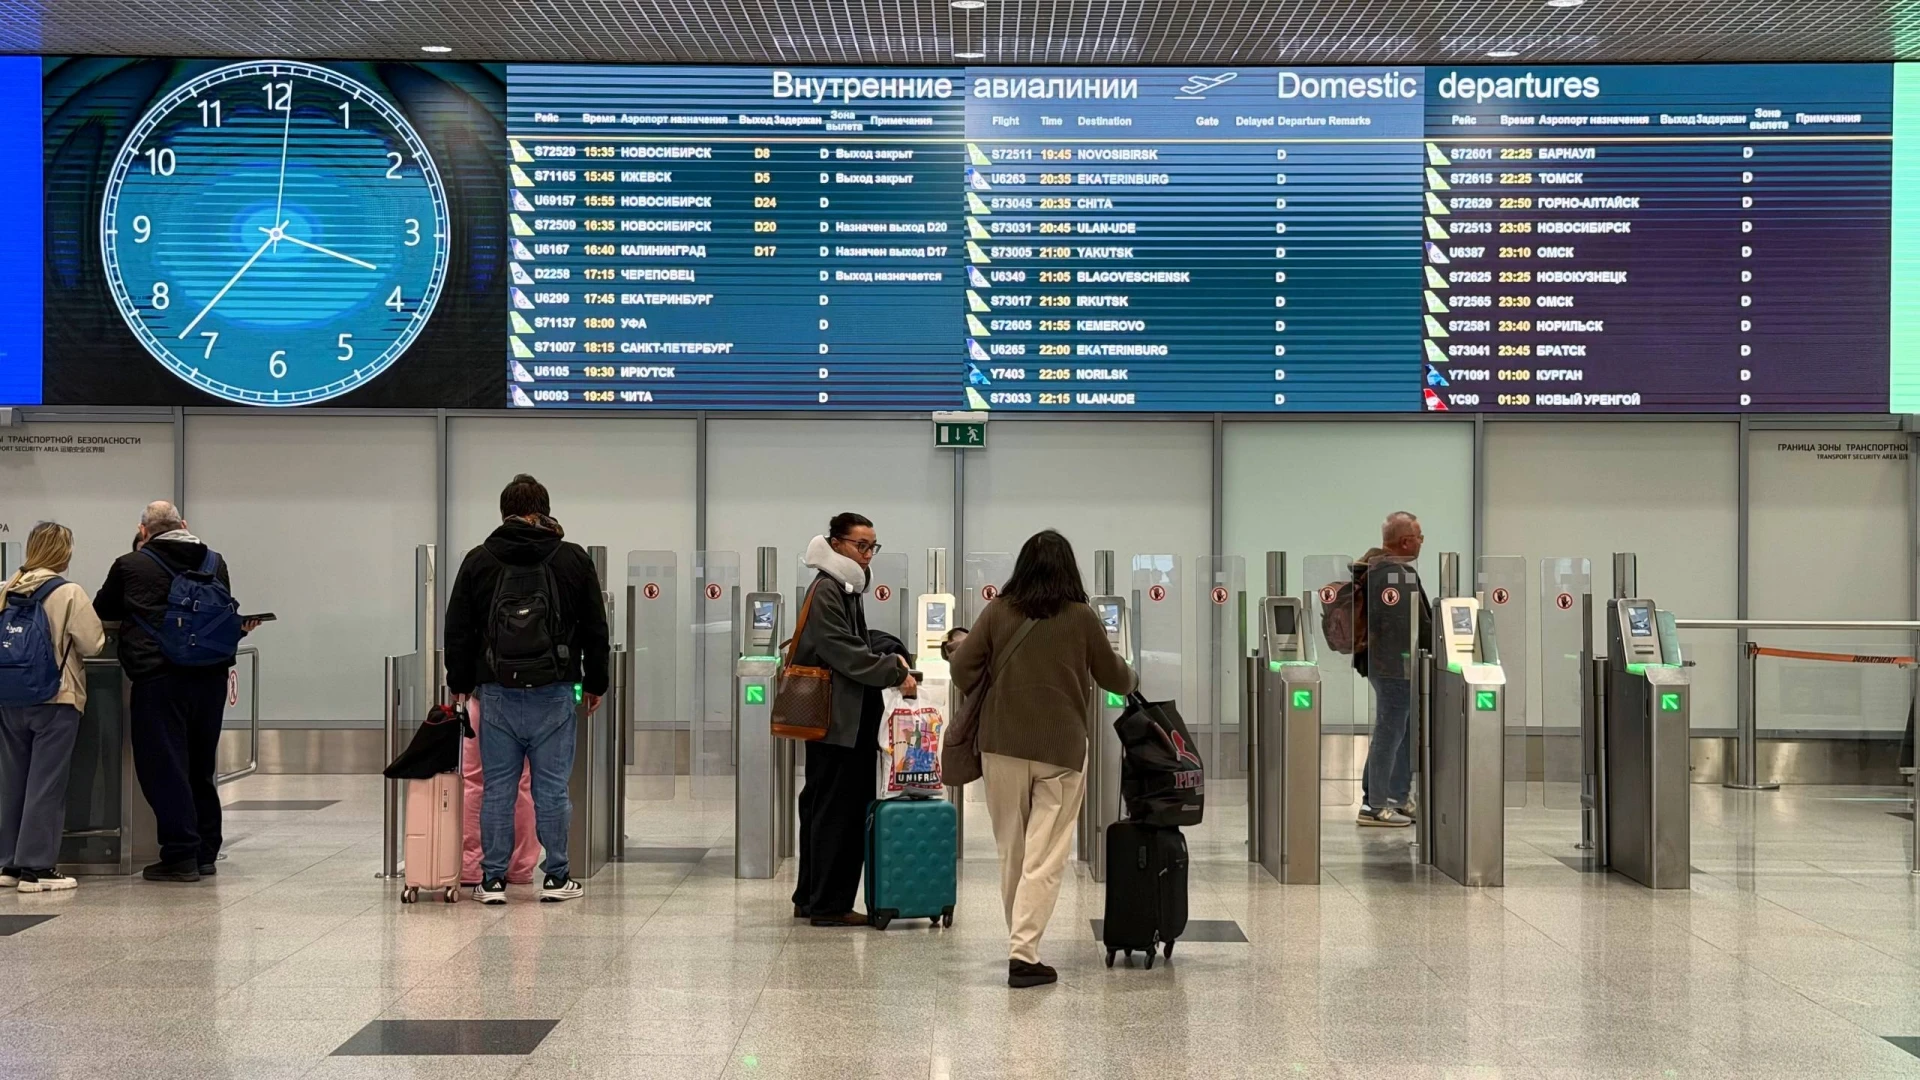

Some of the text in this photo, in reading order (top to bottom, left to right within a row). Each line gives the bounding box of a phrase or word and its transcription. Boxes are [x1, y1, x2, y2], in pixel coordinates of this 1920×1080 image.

[773, 71, 1138, 103] Внутренние авиалинии
[1278, 71, 1600, 103] Domestic departures
[262, 84, 292, 110] 12
[198, 101, 221, 127] 11
[338, 103, 349, 128] 1
[534, 113, 933, 127] Рейс Время Аэропорт назначения Выход Задержан Примечания
[992, 116, 1371, 128] Flight Time Destination Gate Delayed Departure Remarks
[534, 146, 913, 159] S72529 15:35 НОВОСИБИРСК D8 Выход закрыт
[991, 149, 1158, 160] S72511 19:45 NOVOSIBIRSK
[1450, 148, 1595, 159] S72601 22:25 БАРНАУЛ
[145, 149, 175, 176] 10
[386, 154, 402, 179] 2
[534, 171, 913, 184] S71165 15:45 ИЖЕВСК D5 Выход закрыт
[991, 173, 1169, 185] U6263 20:35 EKATERINBURG
[1450, 173, 1583, 184] S72615 22:25 ТОМСК
[534, 195, 777, 208] U69157 15:55 НОВОСИБИРСК D24
[1040, 198, 1113, 209] 20:35 CHITA
[1499, 196, 1639, 209] 22:50 ГОРНО-АЛТАЙСК
[133, 216, 150, 242] 9
[534, 220, 948, 233] S72509 16:35 НОВОСИБИРСК D20 Назначен выход D20
[991, 222, 1136, 233] S73031 20:45 ULAN-UDE
[1450, 222, 1631, 233] S72513 23:05 НОВОСИБИРСК
[404, 220, 420, 246] 3
[534, 244, 947, 258] U6167 16:40 КАЛИНИНГРАД D17 Назначен выход D17
[991, 247, 1134, 258] S73005 21:00 YAKUTSK
[1499, 246, 1574, 258] 23:10 ОМСК
[534, 269, 942, 282] D2258 17:15 ЧЕРЕПОВЕЦ Выход назначается
[991, 271, 1190, 282] U6349 21:05 BLAGOVESCHENSK
[1499, 271, 1627, 284] 23:25 НОВОКУЗНЕЦК
[152, 282, 169, 309] 8
[385, 287, 404, 312] 4
[583, 293, 713, 305] 17:45 ЕКАТЕРИНБУРГ
[991, 296, 1129, 307] S73017 21:30 IRKUTSK
[1499, 296, 1574, 307] 23:30 ОМСК
[534, 317, 647, 329] S71137 18:00 УФА
[991, 320, 1146, 331] S72605 21:55 KEMEROVO
[1499, 320, 1603, 331] 23:40 НОРИЛЬСК
[201, 333, 218, 358] 7
[338, 335, 353, 360] 5
[534, 342, 733, 354] S71007 18:15 САНКТ-ПЕТЕРБУРГ
[1039, 344, 1168, 356] 22:00 EKATERINBURG
[1449, 345, 1586, 356] S73041 23:45 БРАТСК
[270, 351, 286, 378] 6
[534, 366, 675, 378] U6105 19:30 ИРКУТСК
[991, 369, 1128, 380] Y7403 22:05 NORILSK
[1498, 369, 1583, 381] 01:00 КУРГАН
[583, 391, 653, 403] 19:45 ЧИТА
[991, 393, 1135, 404] S73033 22:15 ULAN-UDE
[1448, 392, 1640, 405] YC90 01:30 НОВЫЙ УРЕНГОЙ
[8, 435, 73, 444] ТРАНСПОРТНОЙ
[1778, 444, 1815, 452] ГРАНИЦА
